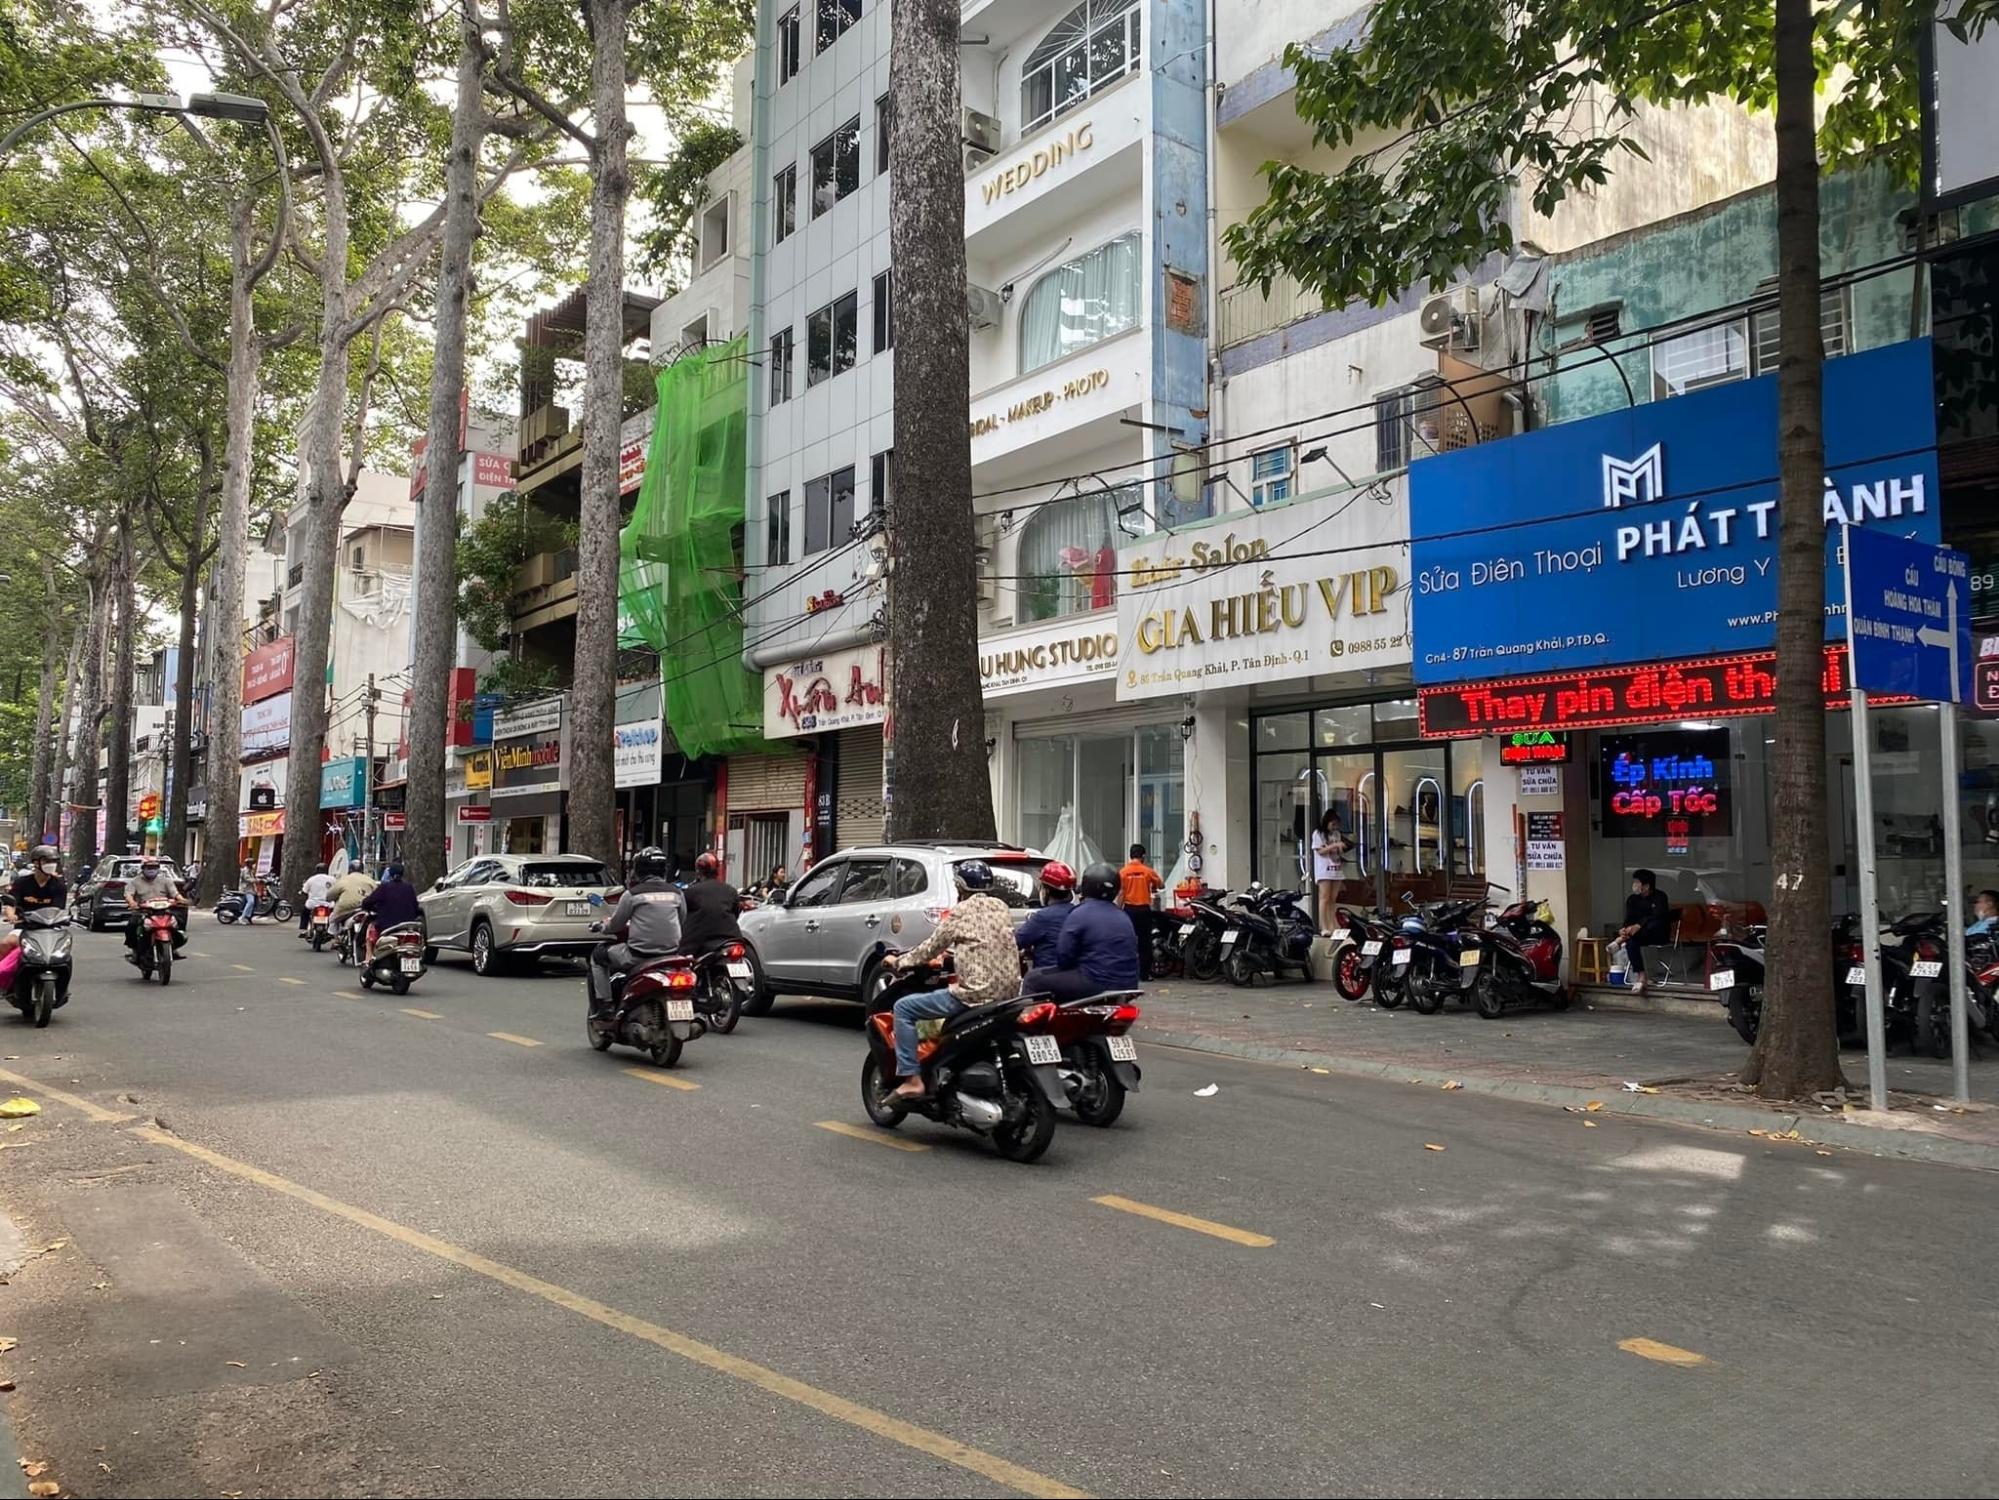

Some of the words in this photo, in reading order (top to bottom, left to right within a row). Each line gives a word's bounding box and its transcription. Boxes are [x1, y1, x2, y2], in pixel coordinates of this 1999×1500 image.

[981, 121, 1094, 205] WEDDING
[1063, 367, 1109, 400] PHOTO
[1617, 500, 1736, 562] PHÁT
[1746, 473, 1925, 538] TÀNH
[1190, 532, 1270, 573] Salon
[1419, 566, 1459, 594] Sửa
[1534, 541, 1602, 574] Thoại
[1677, 566, 1745, 588] Lương
[1754, 557, 1770, 576] Y
[1969, 574, 1994, 592] 89
[1136, 605, 1205, 655] GIA
[1210, 569, 1310, 641] HIẾU
[1316, 565, 1399, 620] VIP
[1908, 595, 1923, 614] HOA
[995, 645, 1047, 676] HUNG
[1049, 632, 1118, 668] STUDIO
[1348, 640, 1373, 655] 0988
[1374, 637, 1387, 650] 55
[1453, 646, 1468, 661] 87
[1496, 640, 1535, 657] Quang
[1174, 667, 1203, 682] Quang
[1231, 660, 1241, 672] P.
[1461, 689, 1546, 723] Thay
[1556, 679, 1615, 720] pin
[1625, 667, 1714, 713] điện
[1614, 752, 1646, 786] Ép
[1653, 755, 1713, 779] Kính
[1612, 789, 1661, 818] Cấp
[1667, 786, 1717, 814] Tốc
[1776, 872, 1804, 891] 47
